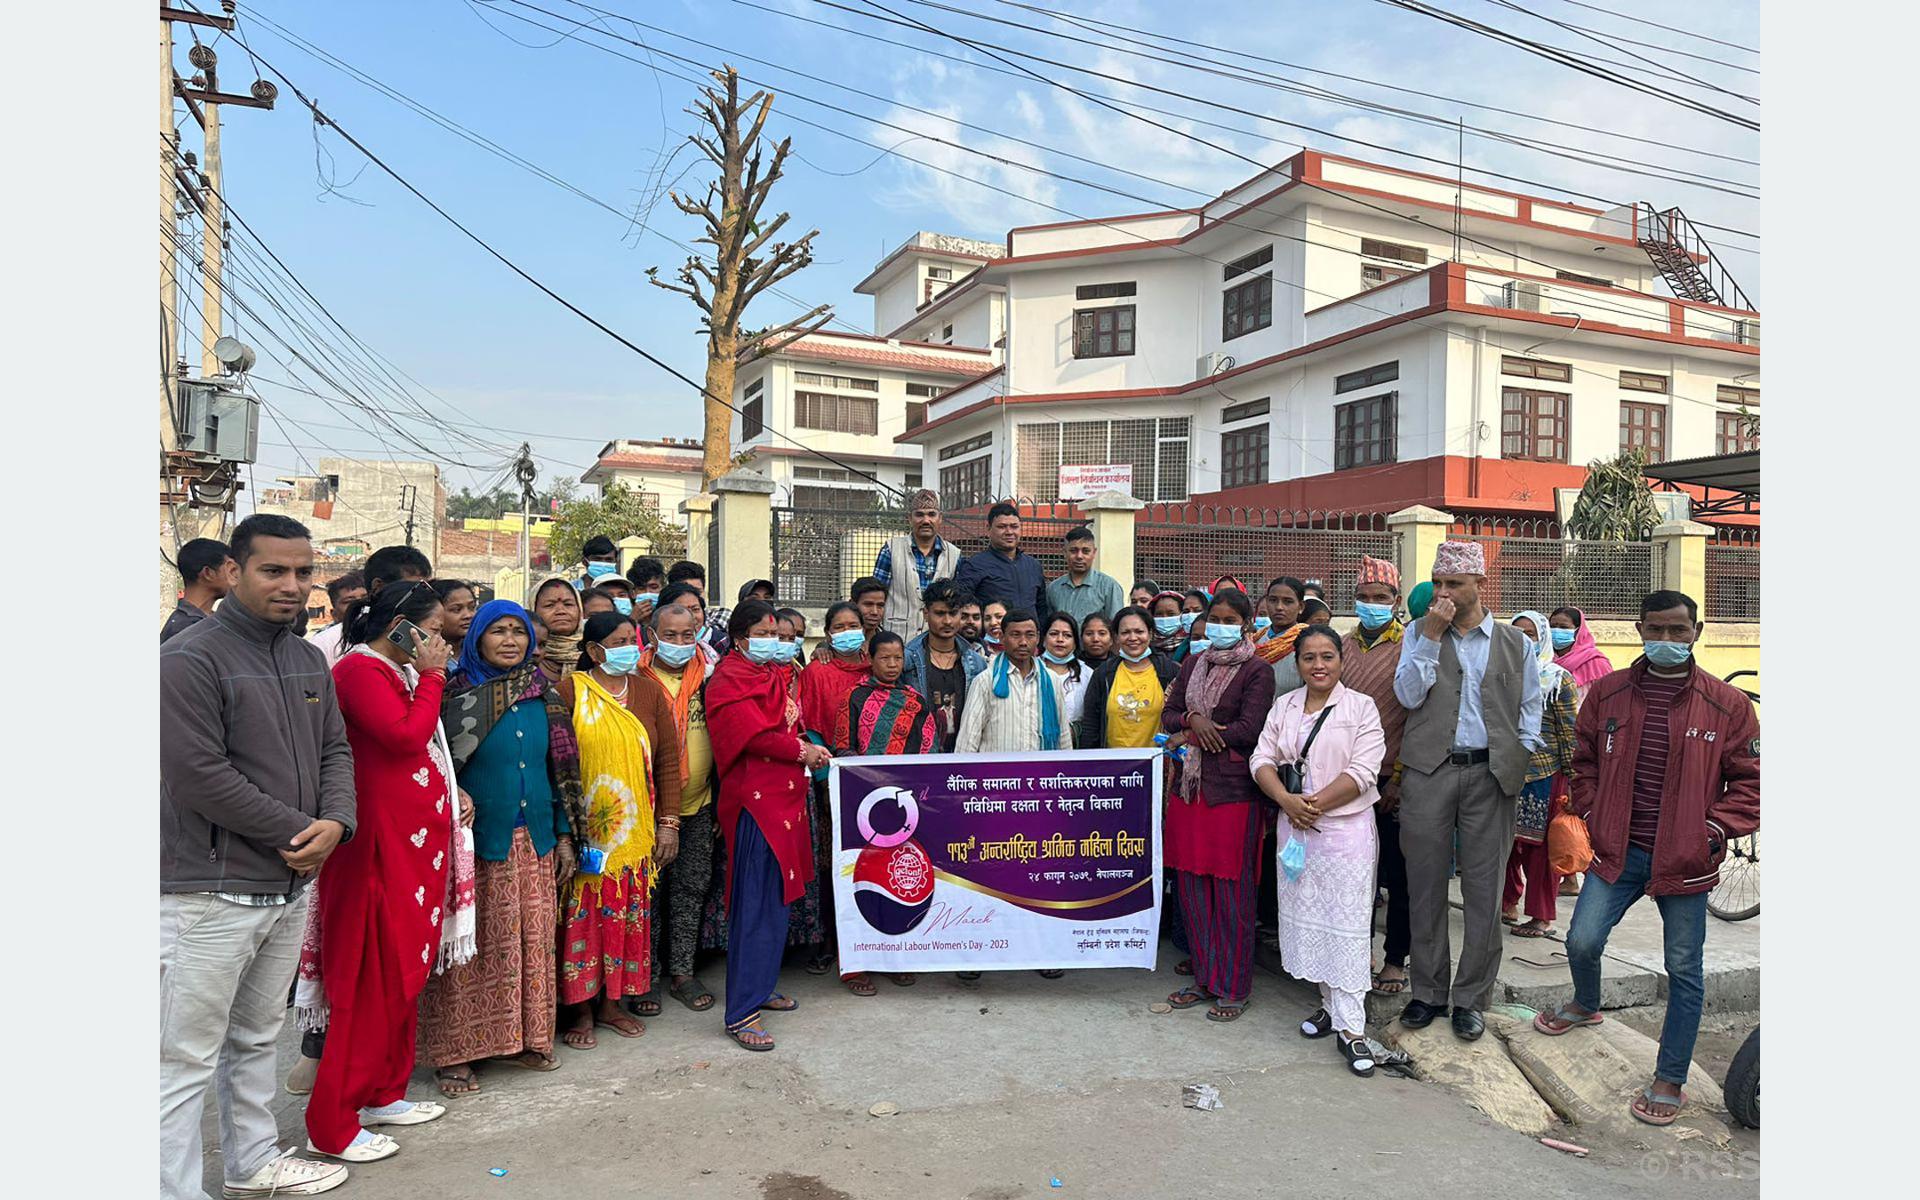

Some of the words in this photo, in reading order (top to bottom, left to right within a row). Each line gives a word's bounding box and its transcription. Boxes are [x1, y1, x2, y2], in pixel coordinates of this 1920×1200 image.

[947, 774, 977, 791] लैंगिक
[982, 777, 1021, 790] समानता
[1027, 777, 1034, 790] र
[1039, 772, 1115, 790] सशक्तिकरणका
[1119, 771, 1144, 788] लागि
[963, 796, 1006, 814] प्रविधिमा
[1011, 799, 1039, 813] दक्षता
[1045, 799, 1053, 812] र
[1058, 795, 1085, 816] नेतृत्व
[1090, 794, 1123, 810] विकास
[1041, 832, 1076, 859] श्रमिक
[1080, 831, 1113, 858] महिला
[1117, 830, 1146, 859] दिवस
[1028, 872, 1040, 882] २४
[1043, 871, 1066, 884] फागुन
[907, 902, 996, 936] March
[854, 941, 902, 951] International
[904, 941, 931, 951] Labour
[931, 940, 967, 950] Women's
[968, 940, 984, 951] Day
[990, 939, 1009, 949] 2023
[1077, 939, 1102, 953] लुम्बिनी
[1104, 939, 1120, 949] प्रदेश
[1123, 938, 1147, 950] कमिटी
